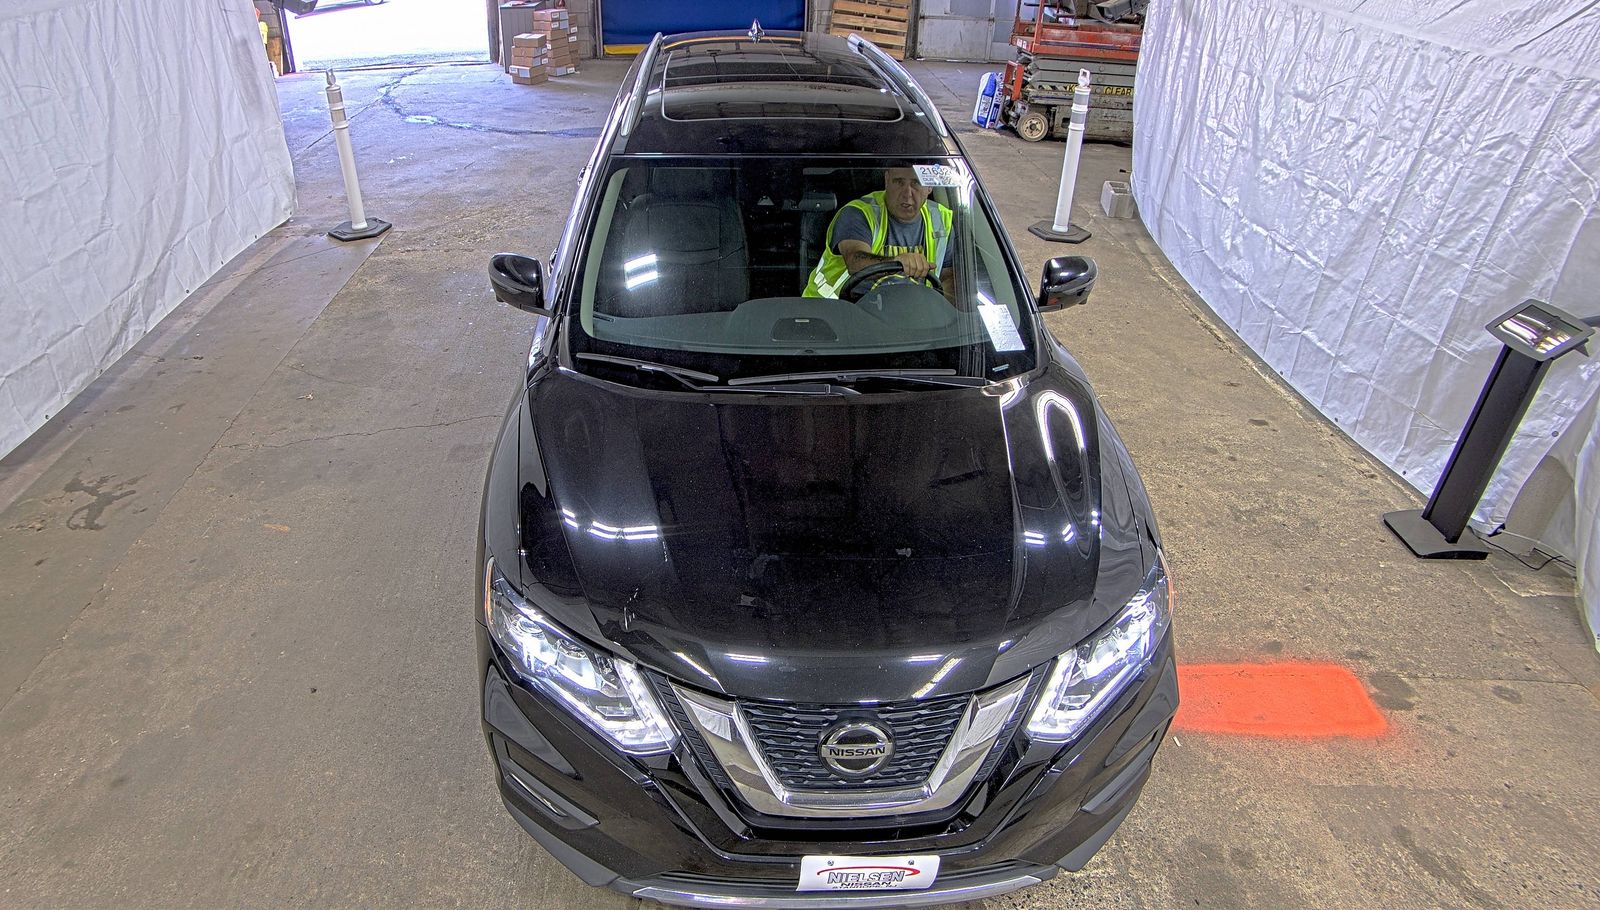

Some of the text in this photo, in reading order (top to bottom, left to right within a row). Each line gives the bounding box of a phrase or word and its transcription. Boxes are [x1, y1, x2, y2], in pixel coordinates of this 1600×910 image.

[1104, 86, 1132, 95] CLEAR
[829, 746, 886, 756] NISSAN
[827, 871, 906, 884] NIELSEN
